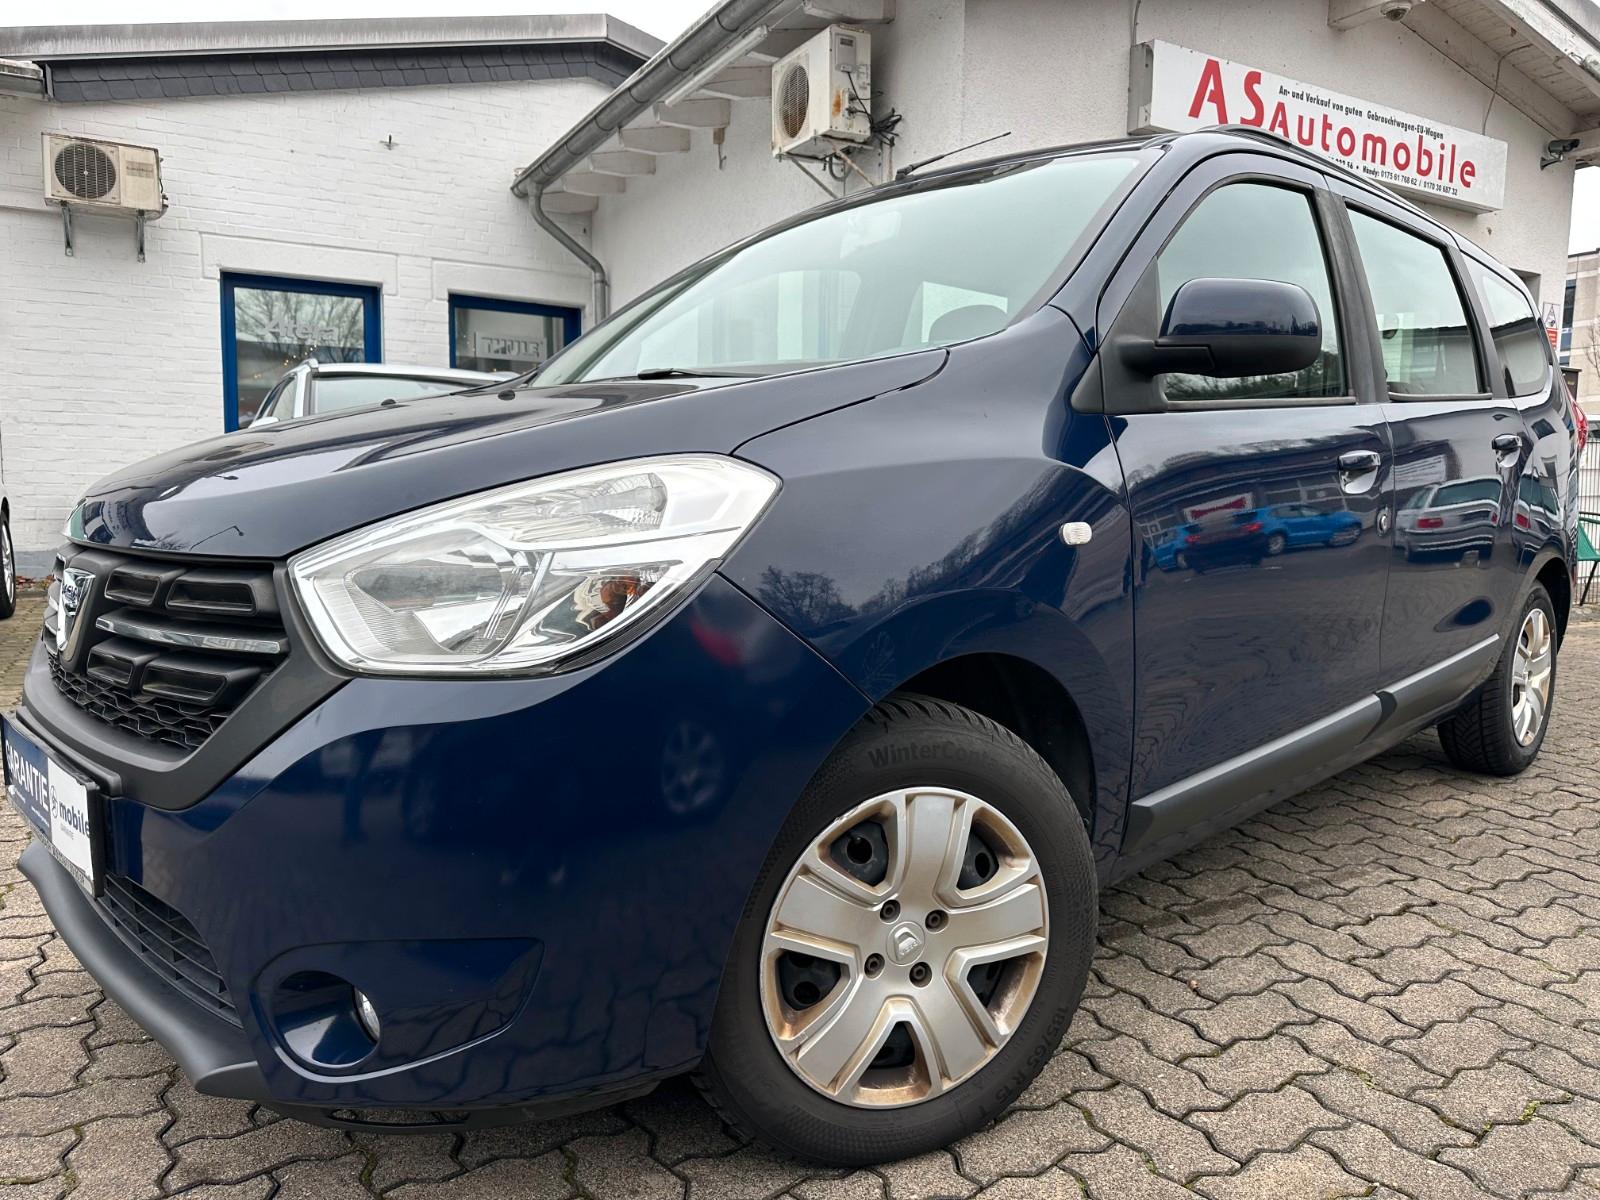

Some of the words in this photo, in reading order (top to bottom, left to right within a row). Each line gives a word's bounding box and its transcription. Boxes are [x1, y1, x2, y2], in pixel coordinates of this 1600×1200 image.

[1279, 85, 1290, 96] An-
[1292, 90, 1304, 101] und
[1306, 92, 1331, 108] Verkauf
[1332, 102, 1343, 112] von
[1344, 106, 1363, 117] guten
[1381, 170, 1393, 181] 0175
